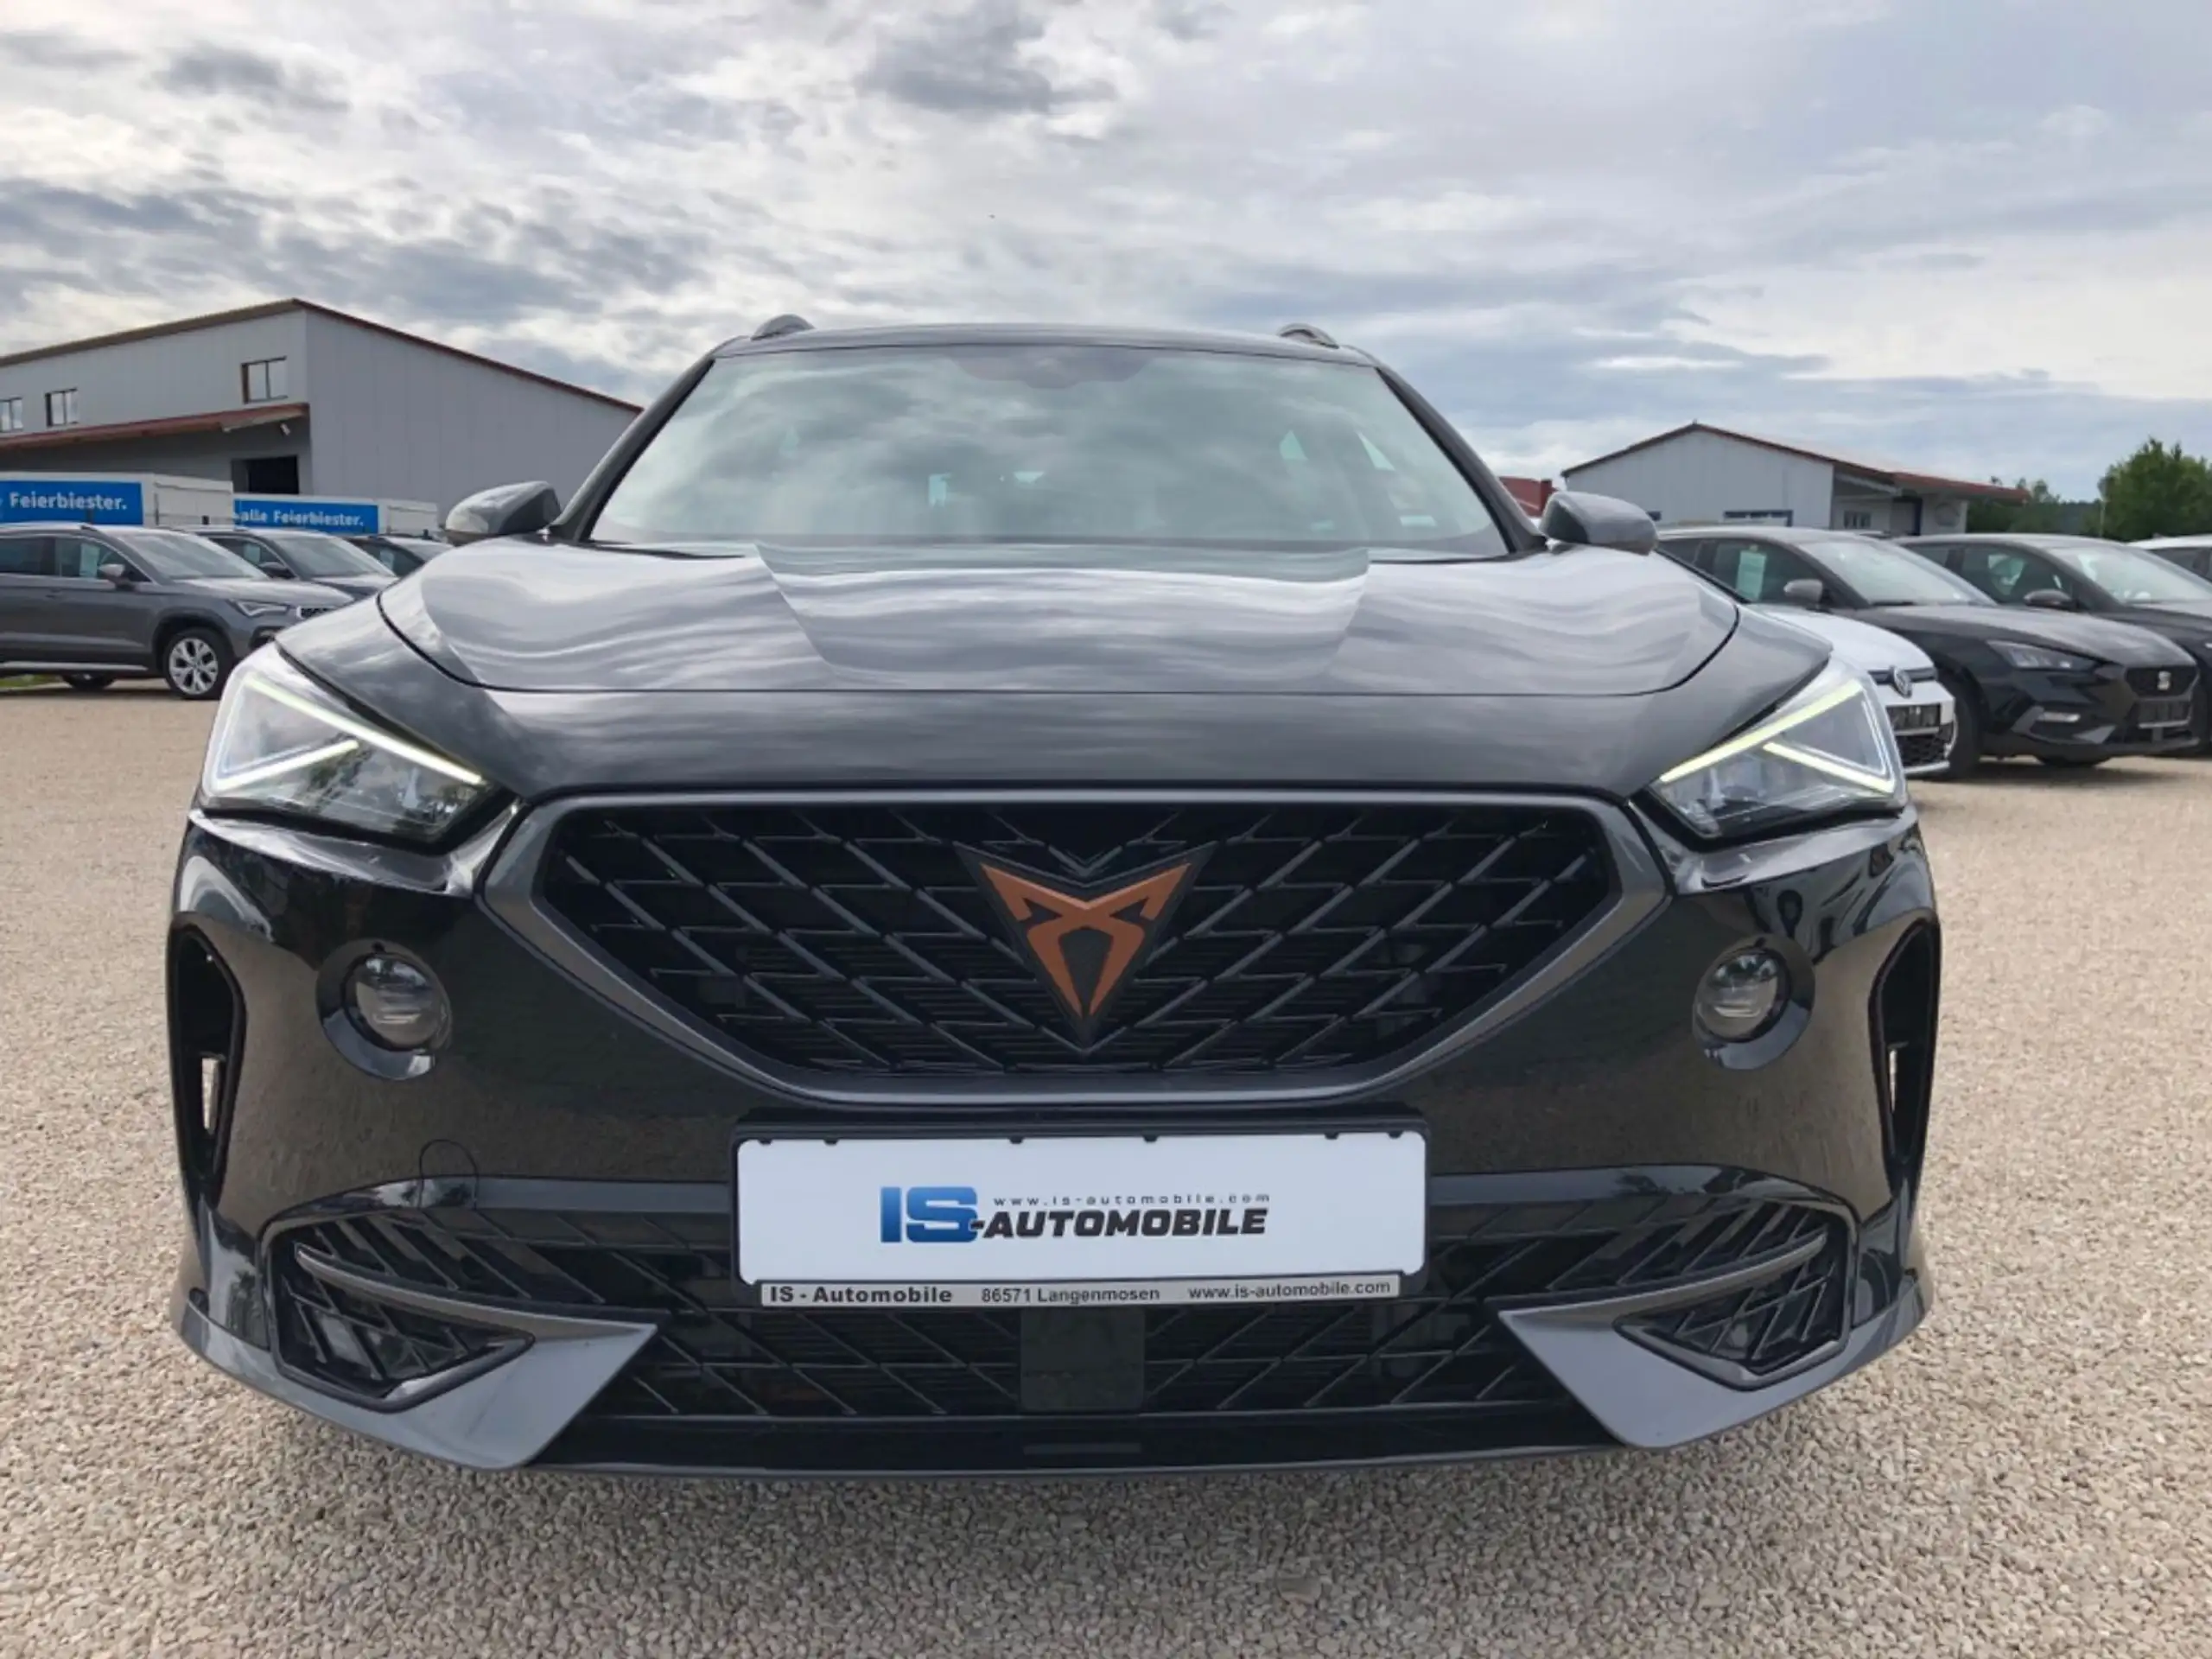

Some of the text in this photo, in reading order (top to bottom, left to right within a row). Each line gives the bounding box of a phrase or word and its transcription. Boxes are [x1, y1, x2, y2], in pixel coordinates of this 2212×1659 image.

[10, 491, 128, 510] Feierbiester.
[273, 509, 364, 526] Feierbiester.
[994, 1193, 1269, 1206] www.is-automobile.com
[812, 1286, 953, 1302] Automobile
[981, 1287, 1032, 1303] 86571
[1038, 1287, 1160, 1304] Langenmosen
[1187, 1281, 1390, 1299] www.is-automobile.com
